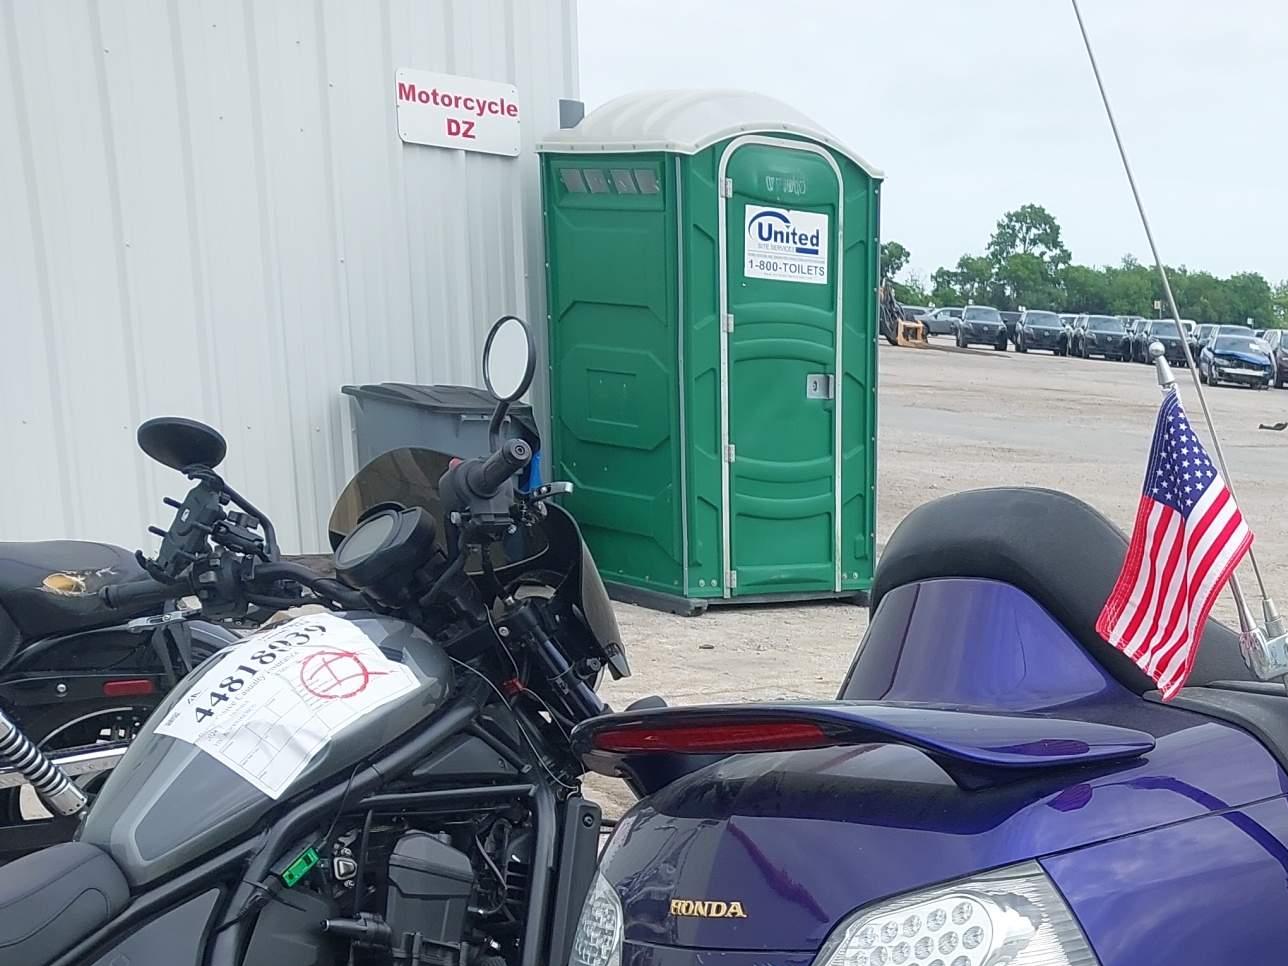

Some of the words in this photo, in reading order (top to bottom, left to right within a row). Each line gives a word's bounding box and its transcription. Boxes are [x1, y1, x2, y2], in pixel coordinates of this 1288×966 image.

[398, 82, 518, 117] Motorcycle
[446, 118, 476, 139] DZ
[757, 222, 820, 247] United
[748, 259, 825, 276] 1-800-TOILETS
[195, 625, 327, 723] 44818039
[671, 899, 747, 918] HONDA
